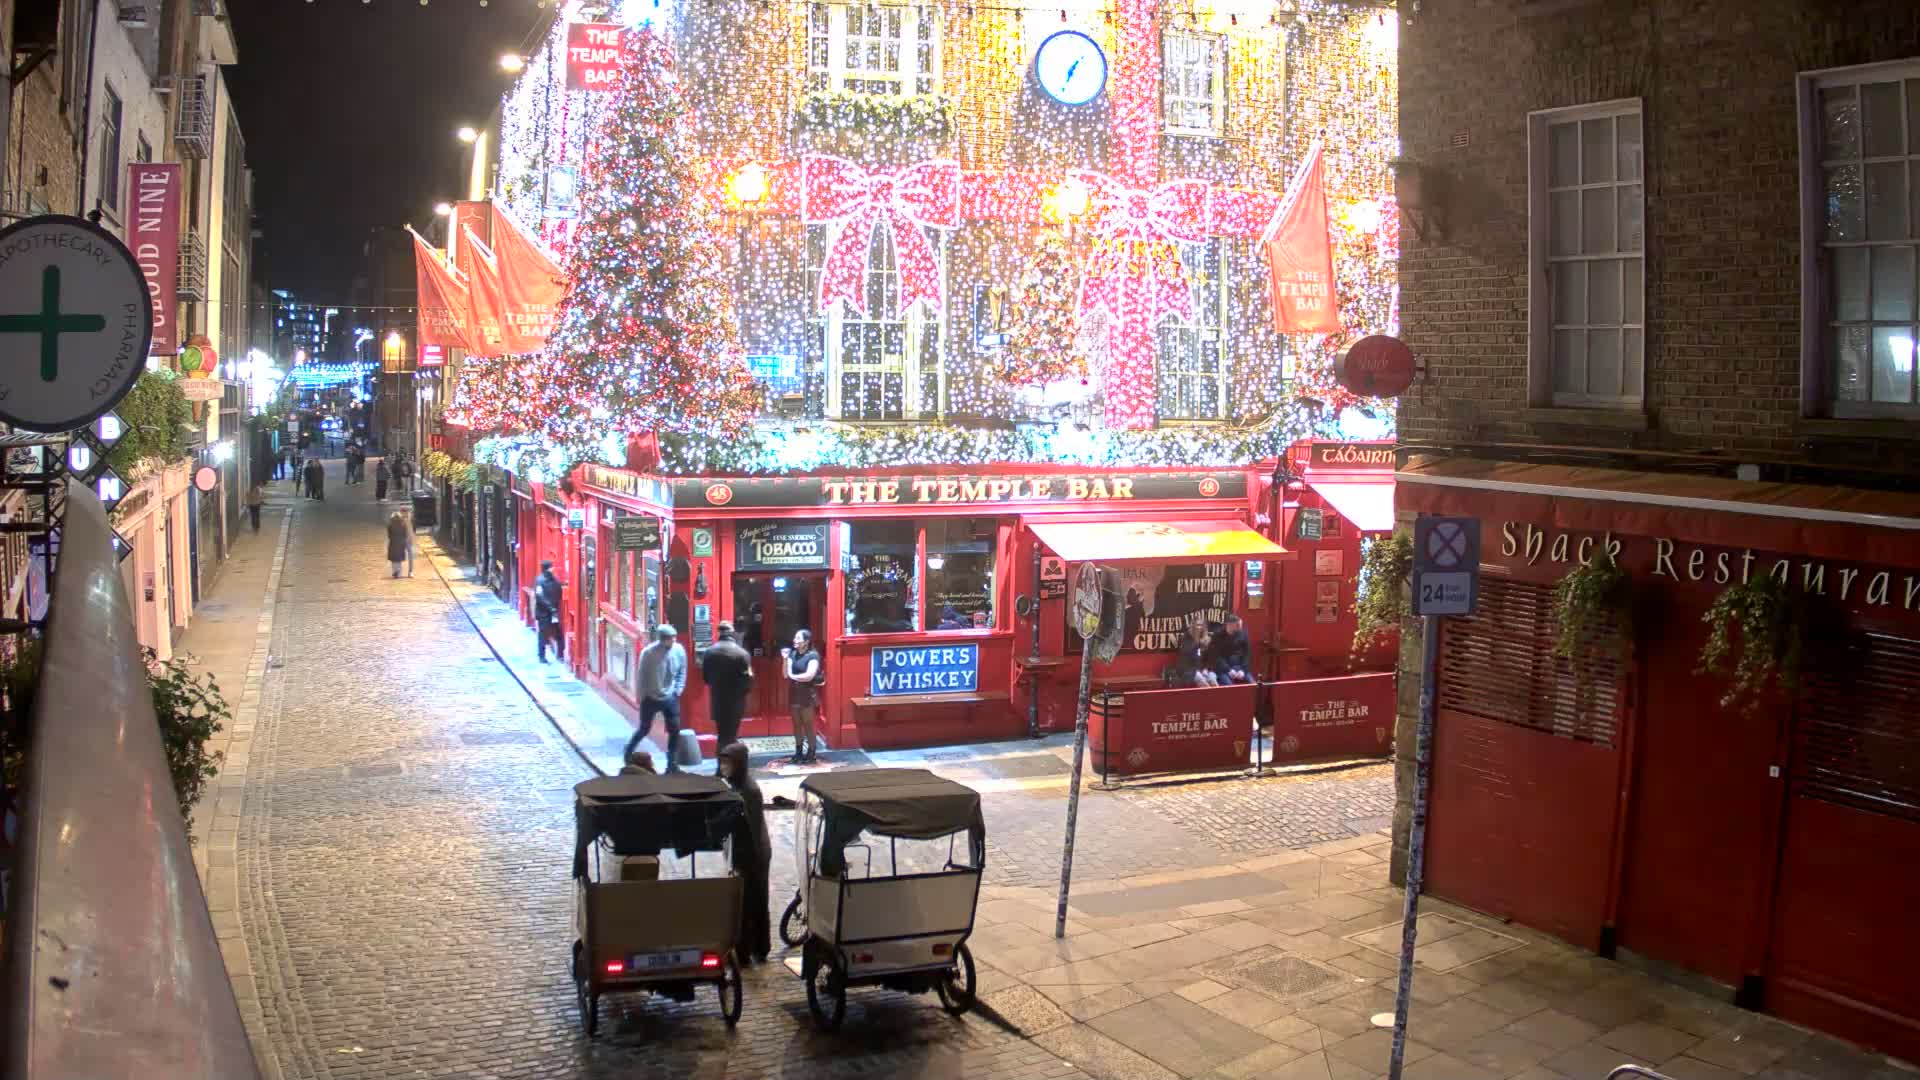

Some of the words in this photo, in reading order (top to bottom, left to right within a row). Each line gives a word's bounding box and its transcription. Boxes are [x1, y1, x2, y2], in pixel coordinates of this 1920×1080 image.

[586, 29, 619, 46] THE
[570, 47, 624, 64] TEMPL
[138, 171, 170, 232] NINE
[505, 313, 555, 325] TEMPL
[90, 303, 136, 399] PHARMACY
[710, 486, 727, 500] 48
[823, 481, 899, 503] THE
[912, 479, 1051, 503] TEMPLE
[1066, 478, 1134, 499] BAR
[751, 538, 817, 562] TOBACCO
[1204, 562, 1228, 577] THE
[1502, 520, 1621, 568] Shack
[1652, 537, 1920, 611] Restauran
[1177, 578, 1227, 593] EMPEROR
[1423, 583, 1444, 602] 24
[1213, 593, 1226, 607] OF
[1138, 617, 1183, 632] MALTED
[1133, 633, 1184, 650] GUIN
[881, 647, 970, 668] POWER'S
[875, 670, 975, 691] WHISKEY
[1300, 708, 1345, 721] TEMPLE
[1347, 705, 1369, 718] BAR
[1327, 700, 1345, 709] THE
[1181, 712, 1200, 721] THE
[1151, 721, 1200, 734] TEMPLE
[1204, 718, 1229, 731] BAR
